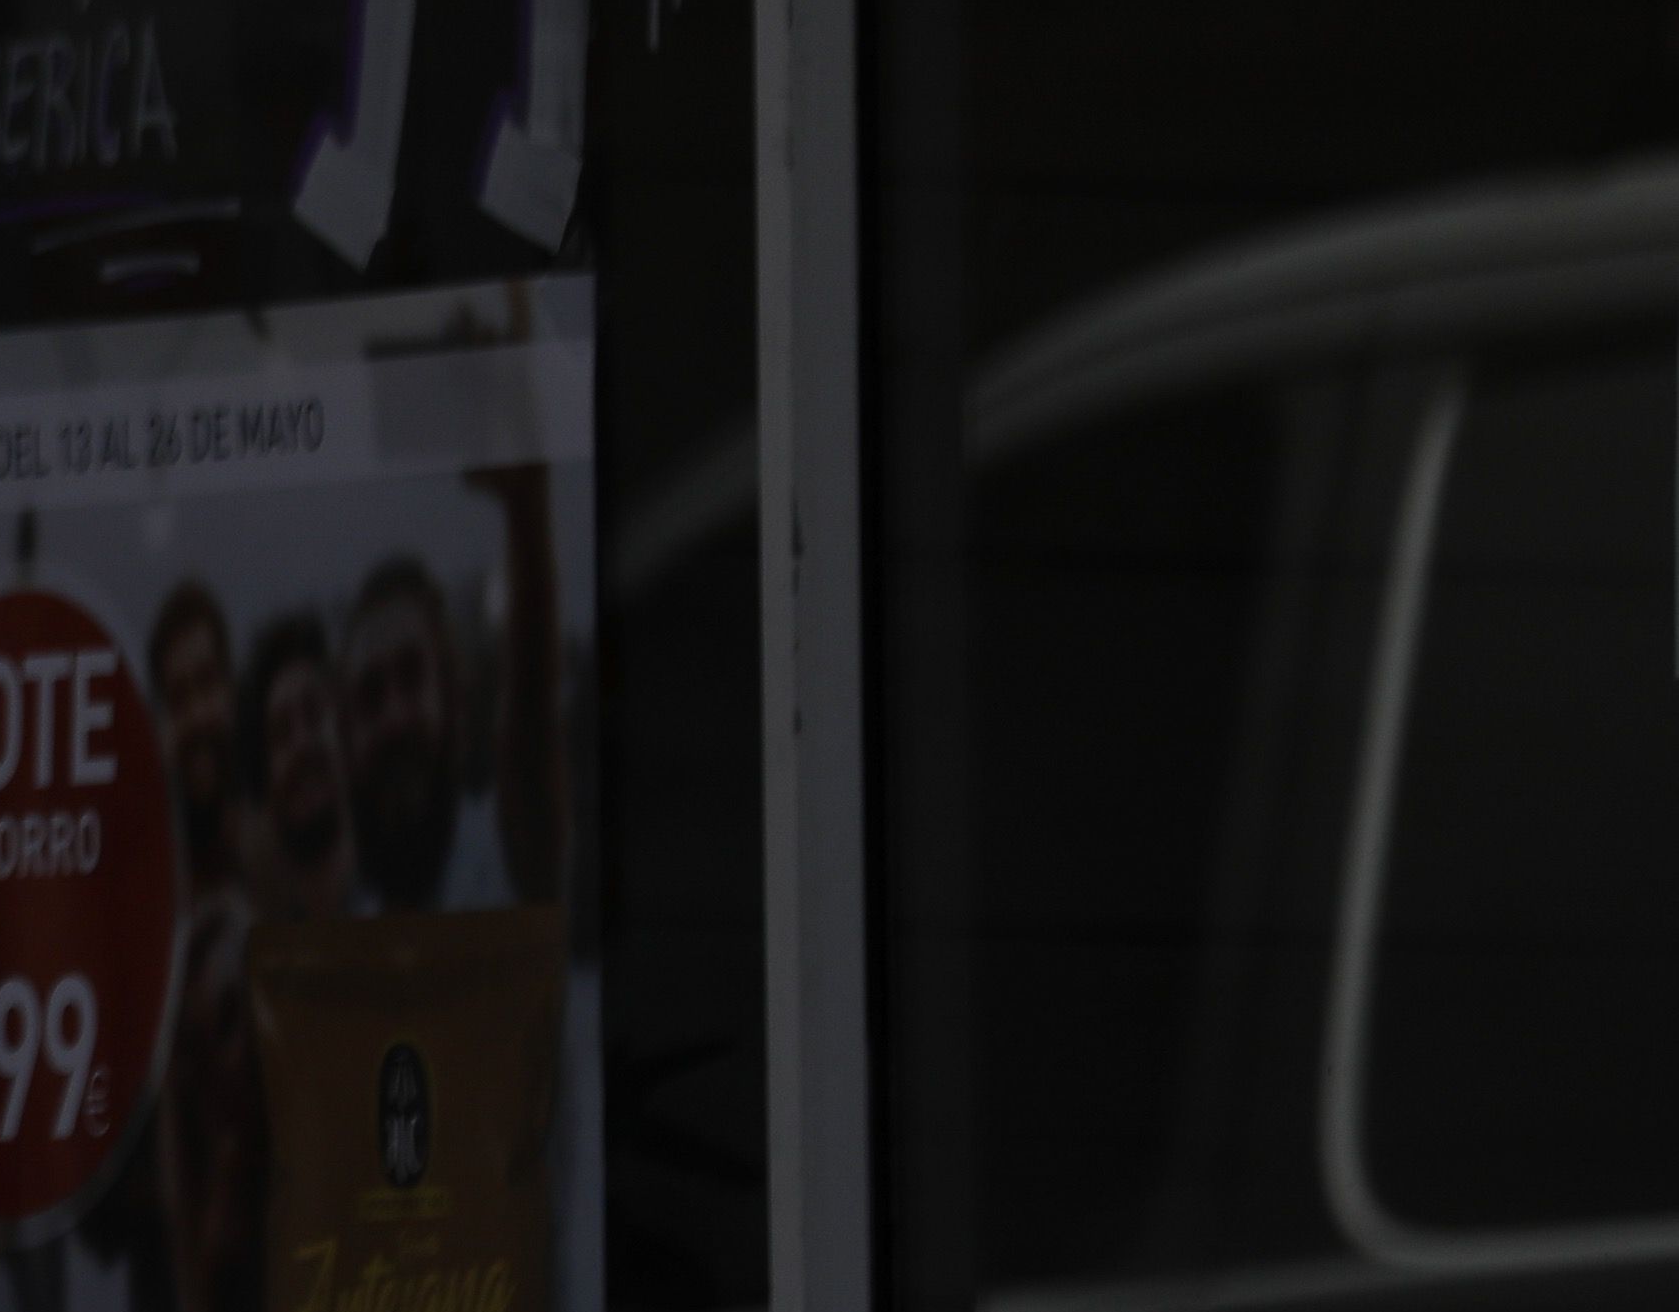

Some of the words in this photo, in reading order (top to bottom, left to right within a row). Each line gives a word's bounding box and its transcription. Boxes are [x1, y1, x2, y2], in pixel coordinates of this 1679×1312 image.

[59, 419, 92, 474] 13
[99, 414, 138, 470] AL
[146, 410, 182, 468] 26
[190, 405, 233, 463] DE
[237, 396, 327, 459] MAYO
